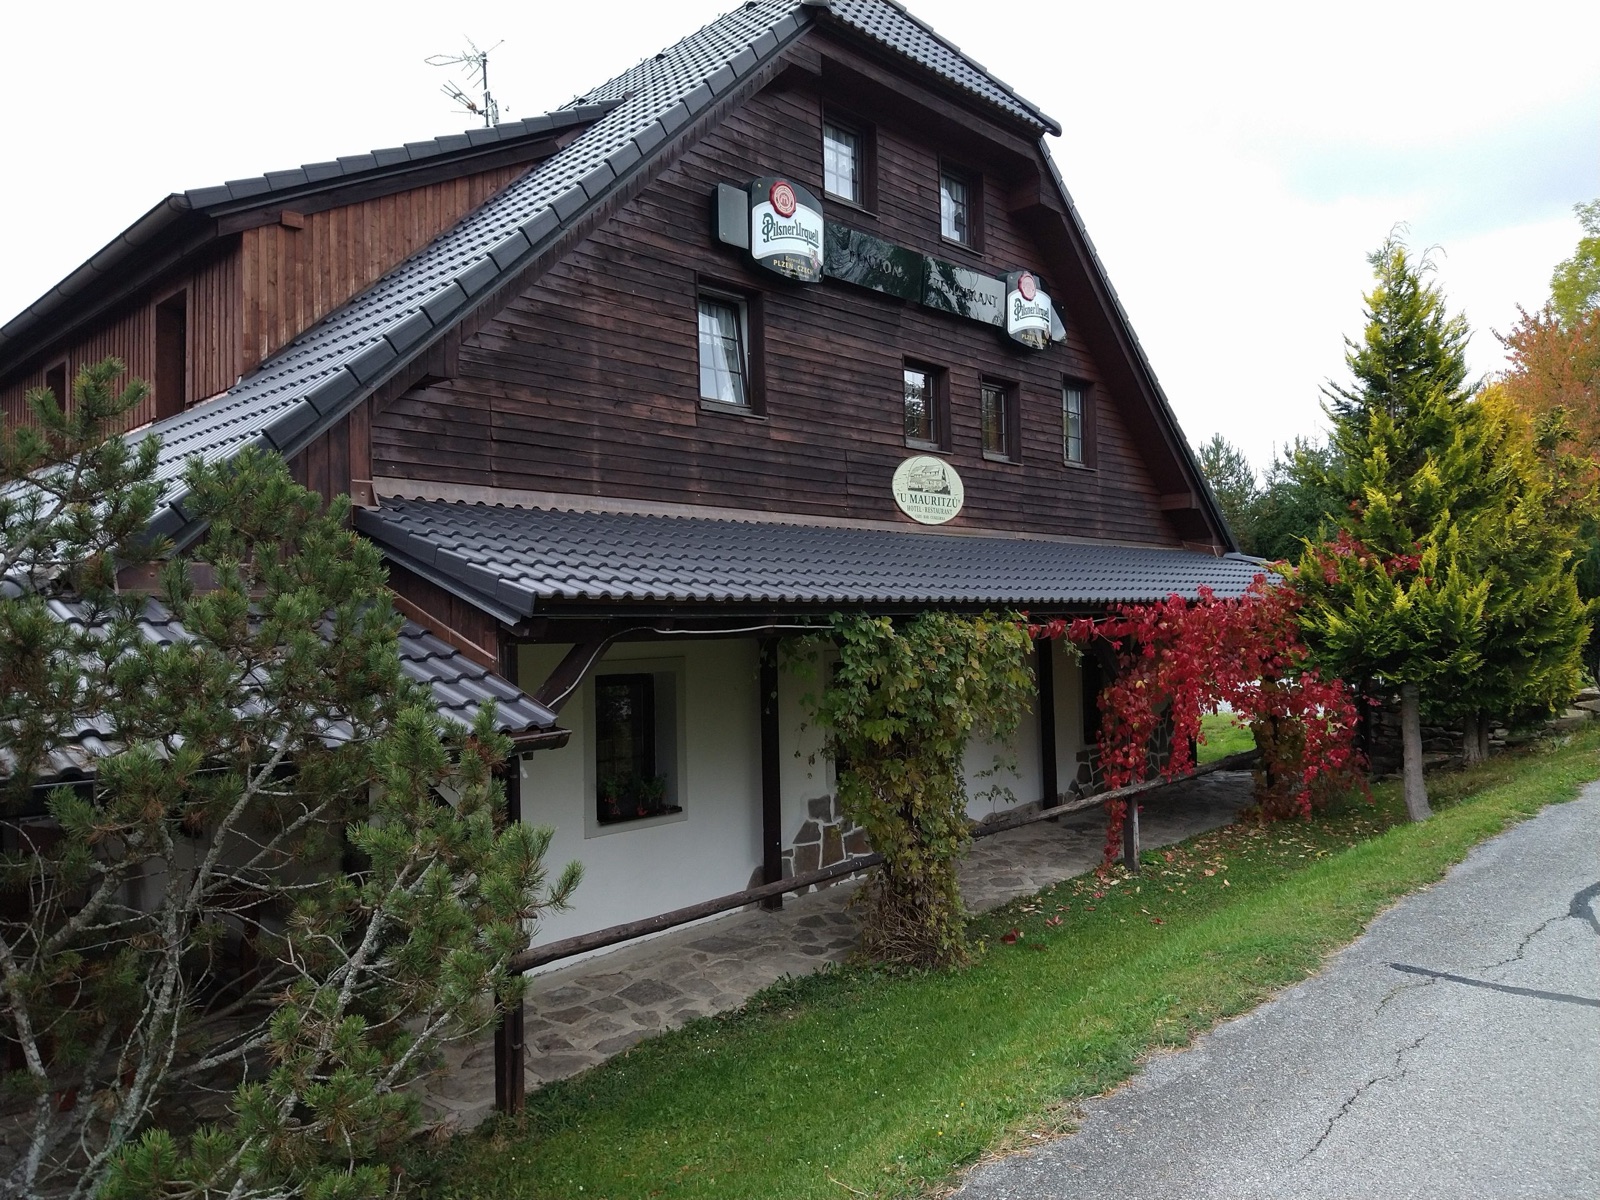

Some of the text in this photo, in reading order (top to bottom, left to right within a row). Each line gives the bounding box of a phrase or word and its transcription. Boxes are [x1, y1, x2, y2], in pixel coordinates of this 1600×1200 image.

[762, 213, 819, 246] Pilsner Urquell
[933, 278, 998, 309] REAURANT
[1014, 298, 1035, 321] Pilsner
[907, 505, 953, 516] HOTEL RESTAURANT
